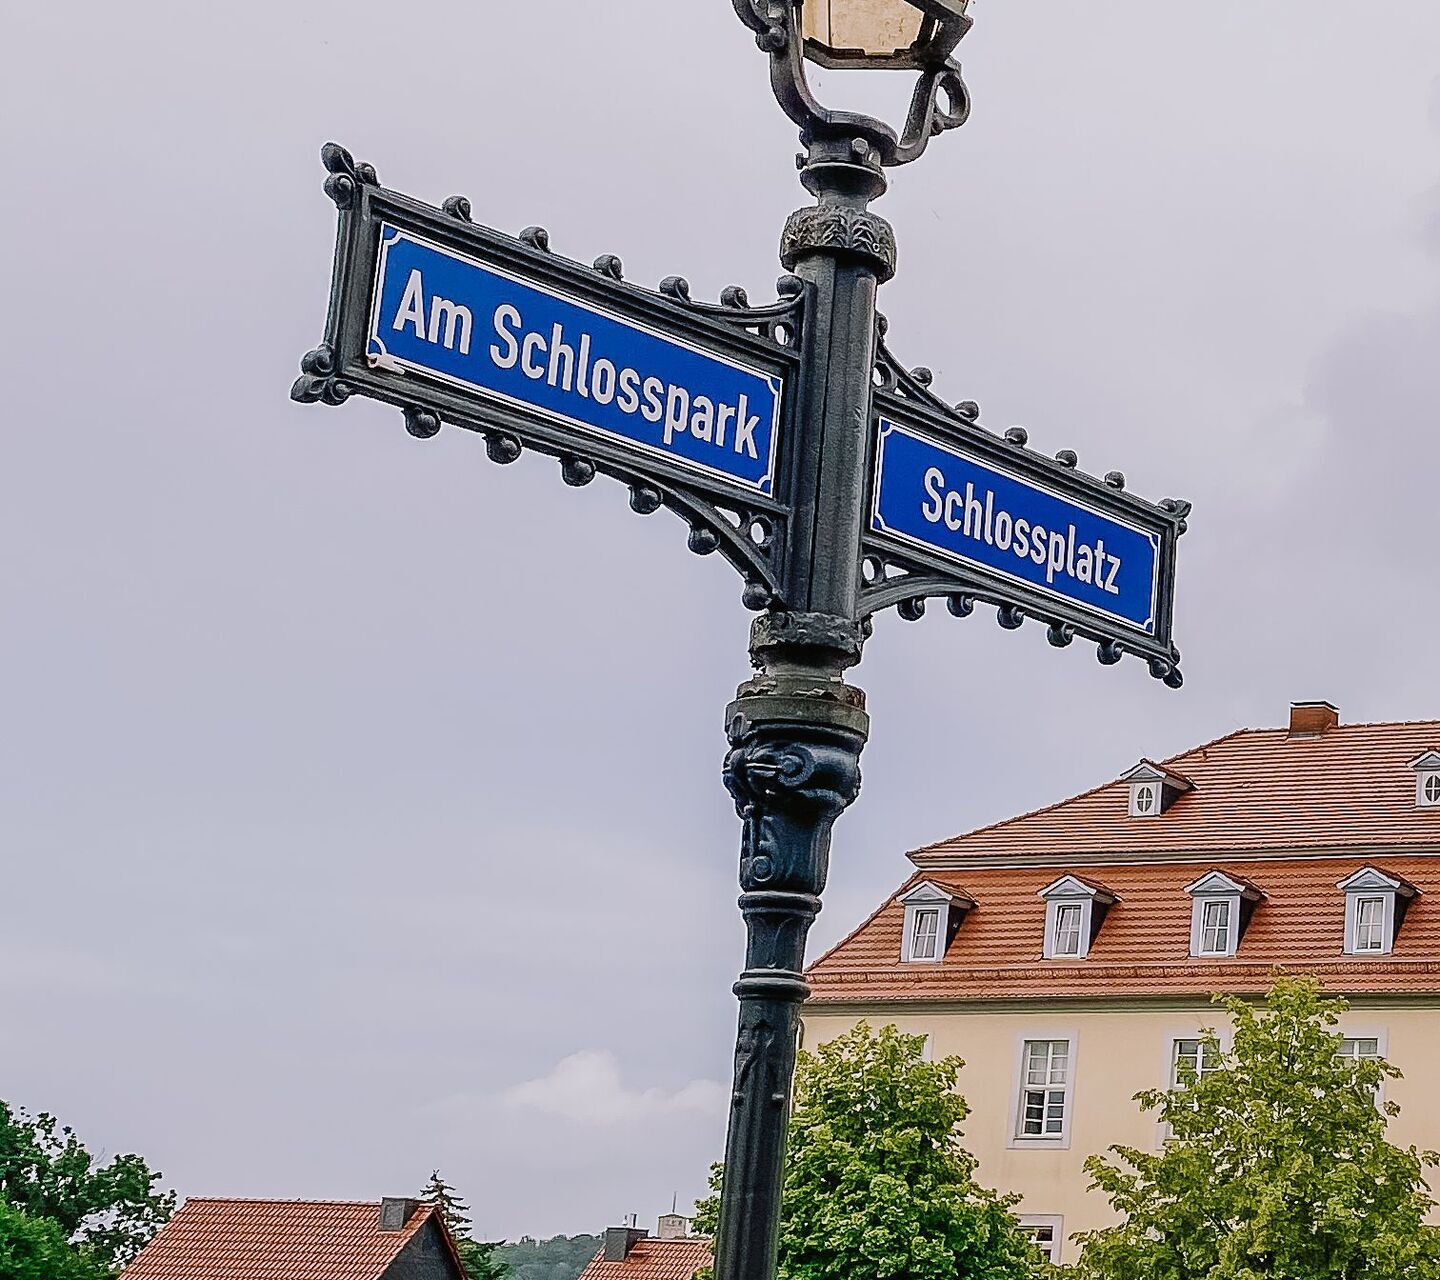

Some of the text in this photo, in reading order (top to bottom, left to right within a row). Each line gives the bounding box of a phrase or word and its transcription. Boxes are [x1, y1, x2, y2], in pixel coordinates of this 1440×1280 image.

[393, 269, 760, 459] Am Schlosspark
[922, 467, 1121, 595] Schlossplatz
